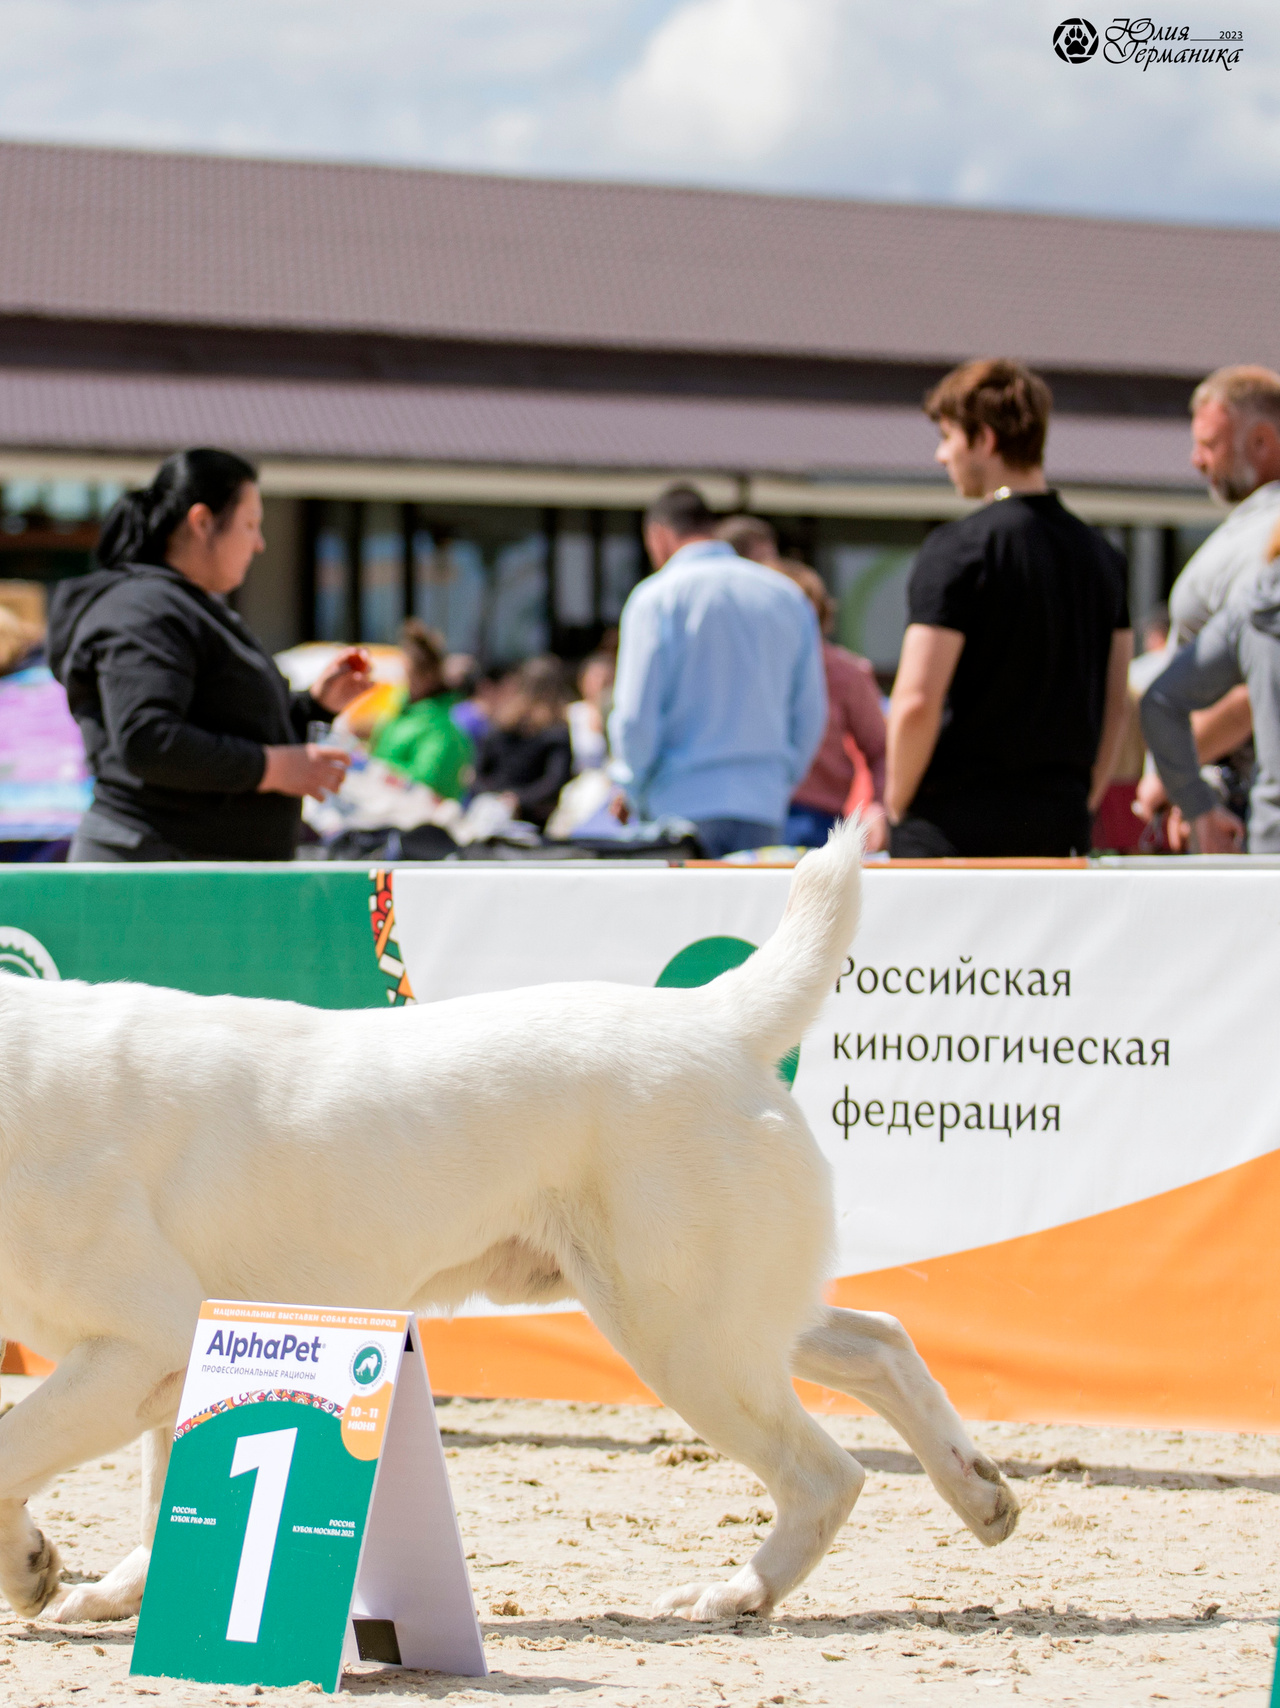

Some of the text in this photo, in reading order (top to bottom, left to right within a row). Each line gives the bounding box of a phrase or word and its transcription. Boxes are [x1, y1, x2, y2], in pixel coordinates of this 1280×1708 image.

[836, 954, 1071, 997] Российская
[833, 1032, 1171, 1067] кинологическая
[831, 1084, 1061, 1143] федерация
[213, 1307, 397, 1328] НАЦИОНАЛЬНЫЕ ВЫСТАВКИ СОБАК ВСЕХ ПОРОД
[205, 1329, 322, 1364] AlphaPet
[201, 1364, 317, 1380] ПРОФЕССИОНАЛЬНЫЕ РАЦИОНЫ
[350, 1406, 362, 1417] 10
[369, 1408, 379, 1419] 11
[347, 1420, 376, 1432] ИЮНЯ
[170, 1515, 190, 1523] КУБОК
[190, 1516, 203, 1524] РКФ
[226, 1427, 298, 1643] 1
[292, 1525, 313, 1534] КУБОК
[313, 1527, 340, 1536] МОСКВЫ
